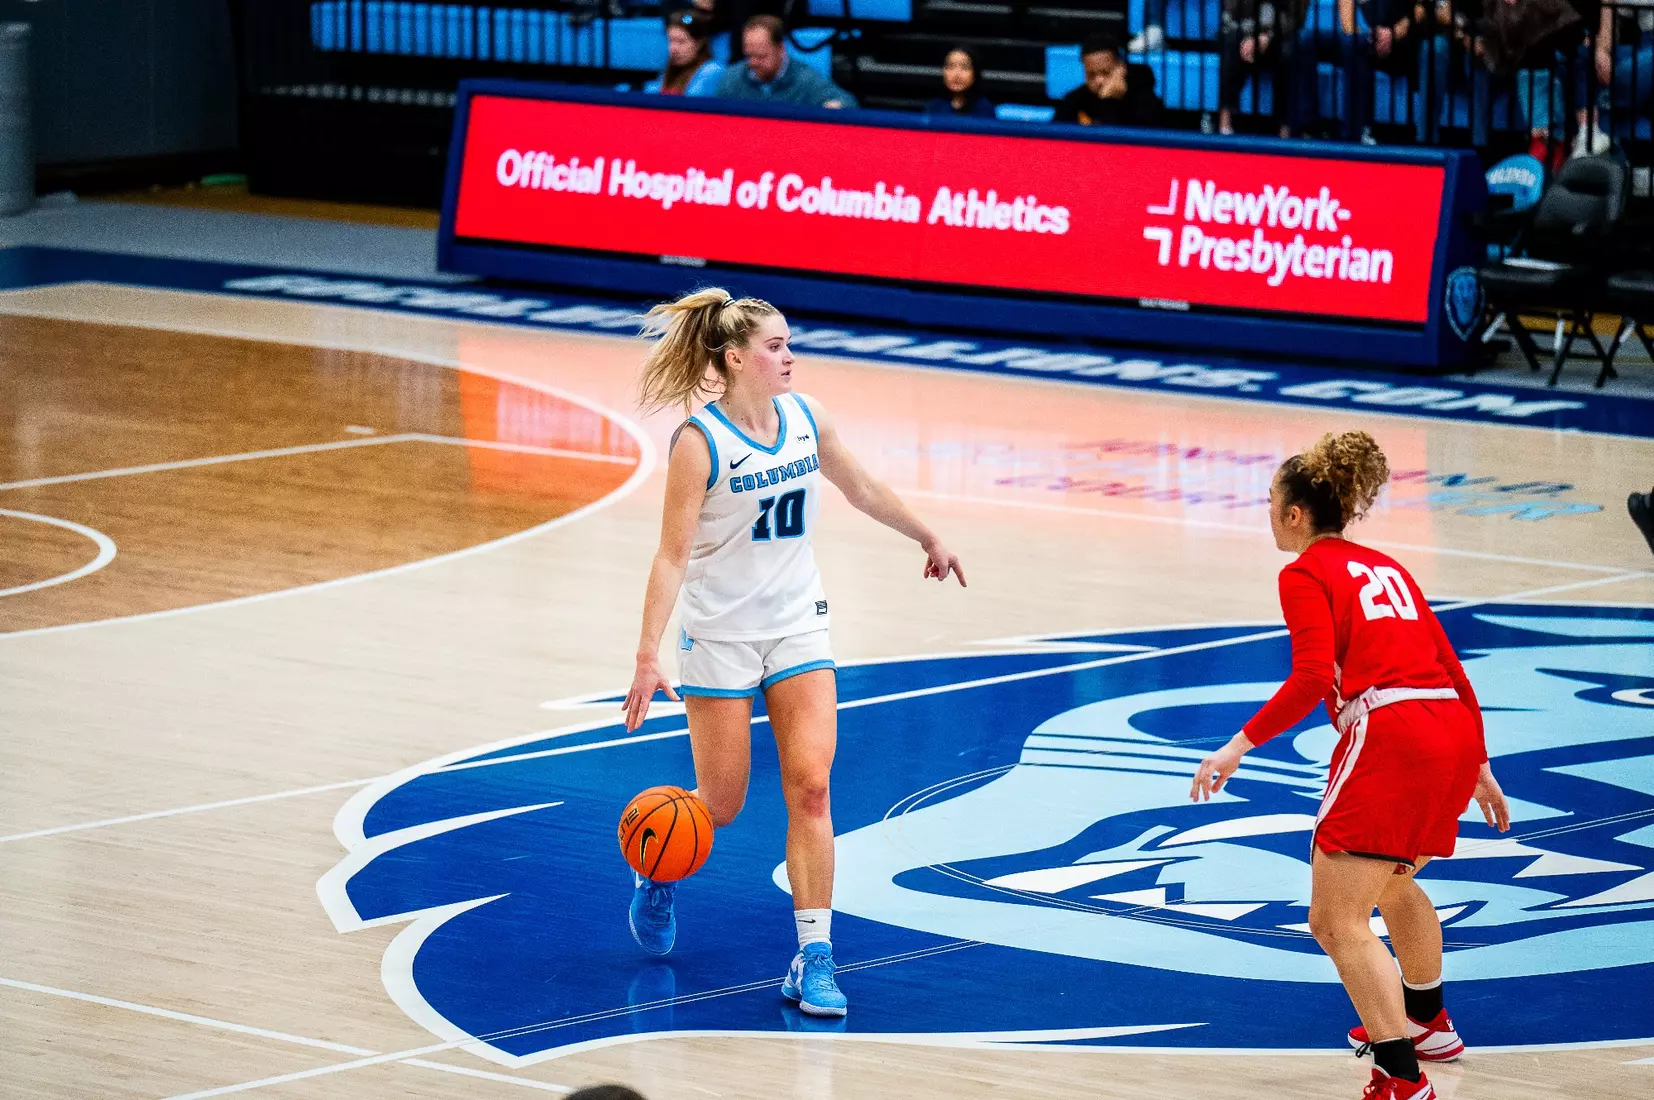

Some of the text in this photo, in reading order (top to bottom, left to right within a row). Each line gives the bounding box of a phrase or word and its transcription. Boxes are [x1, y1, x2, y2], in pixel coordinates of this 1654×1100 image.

[497, 149, 1069, 234] Official Hospital of Columbia Athletics
[1184, 178, 1352, 232] NewYork-
[1179, 224, 1394, 287] Presbyterian
[729, 453, 820, 494] COLUMBIA
[751, 487, 807, 542] 10
[1346, 560, 1419, 622] 20
